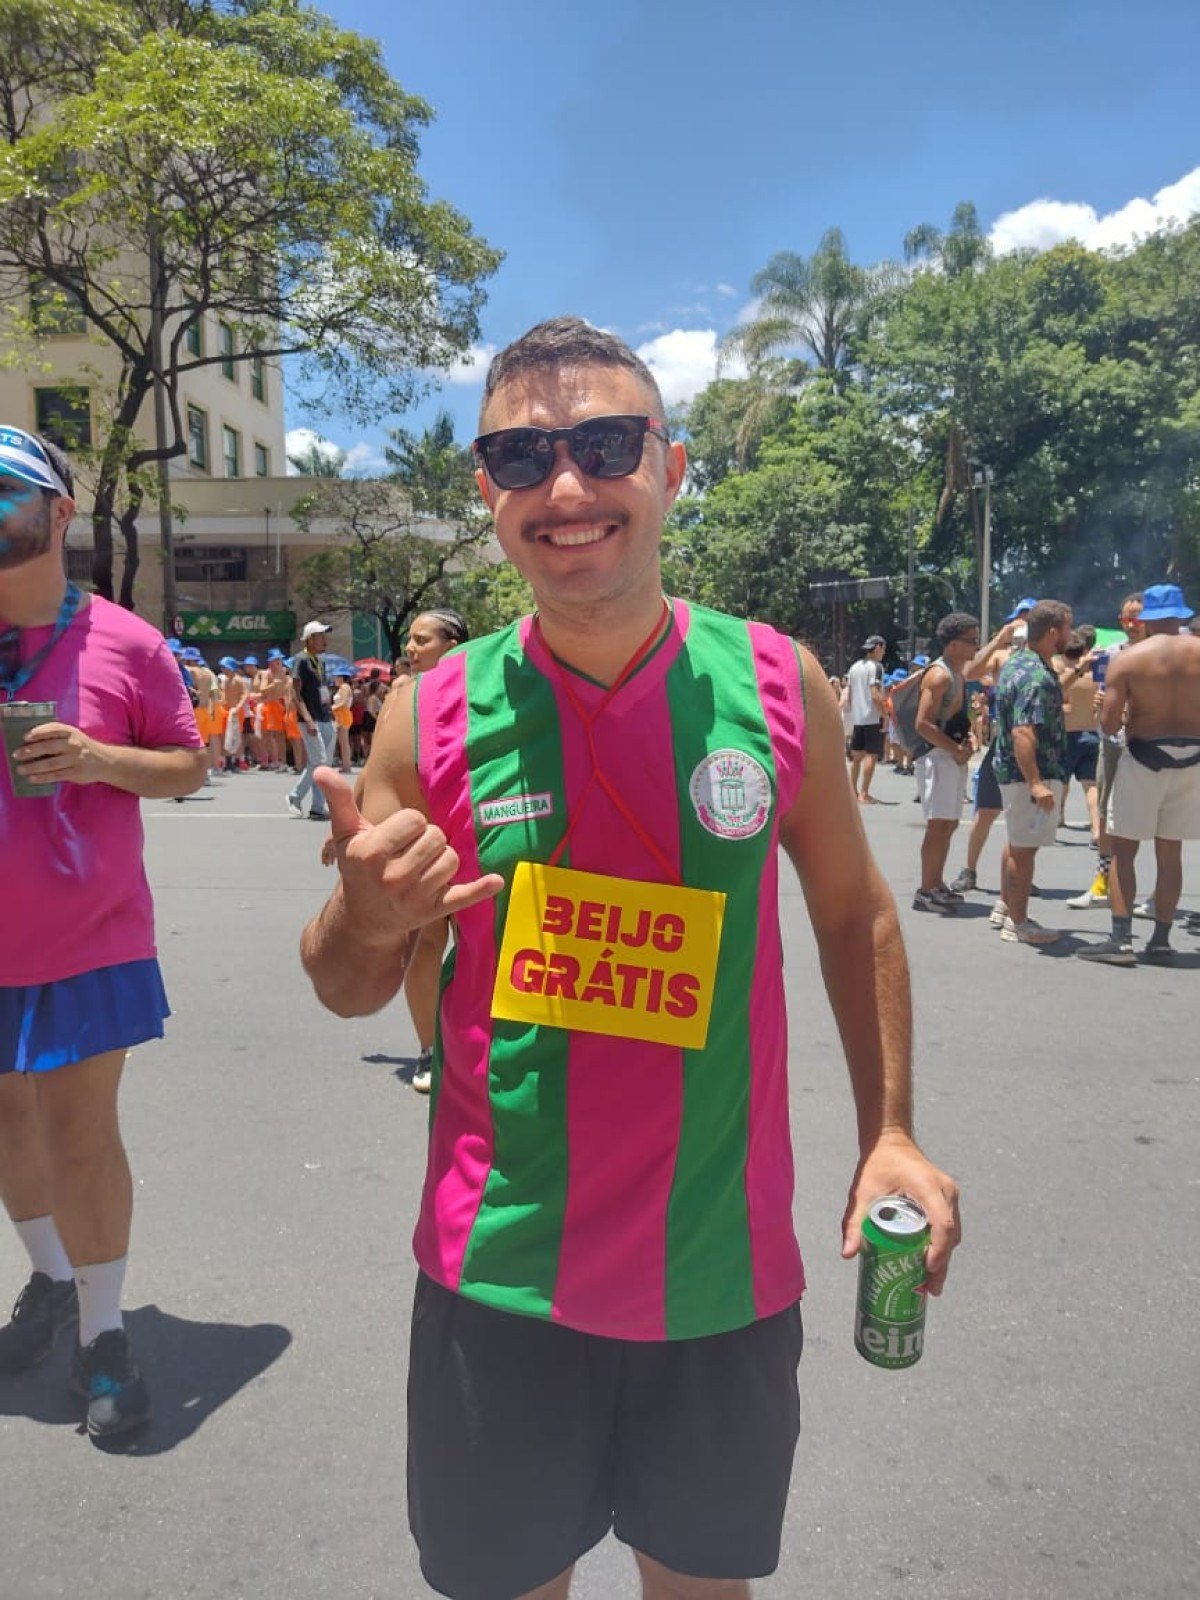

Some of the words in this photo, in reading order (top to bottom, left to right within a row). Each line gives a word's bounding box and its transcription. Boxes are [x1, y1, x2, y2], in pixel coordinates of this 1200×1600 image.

[226, 615, 271, 630] AGIL
[483, 799, 549, 821] MANGUEIRA
[541, 895, 686, 953] BEIJO
[510, 947, 701, 1019] GRÁTIS
